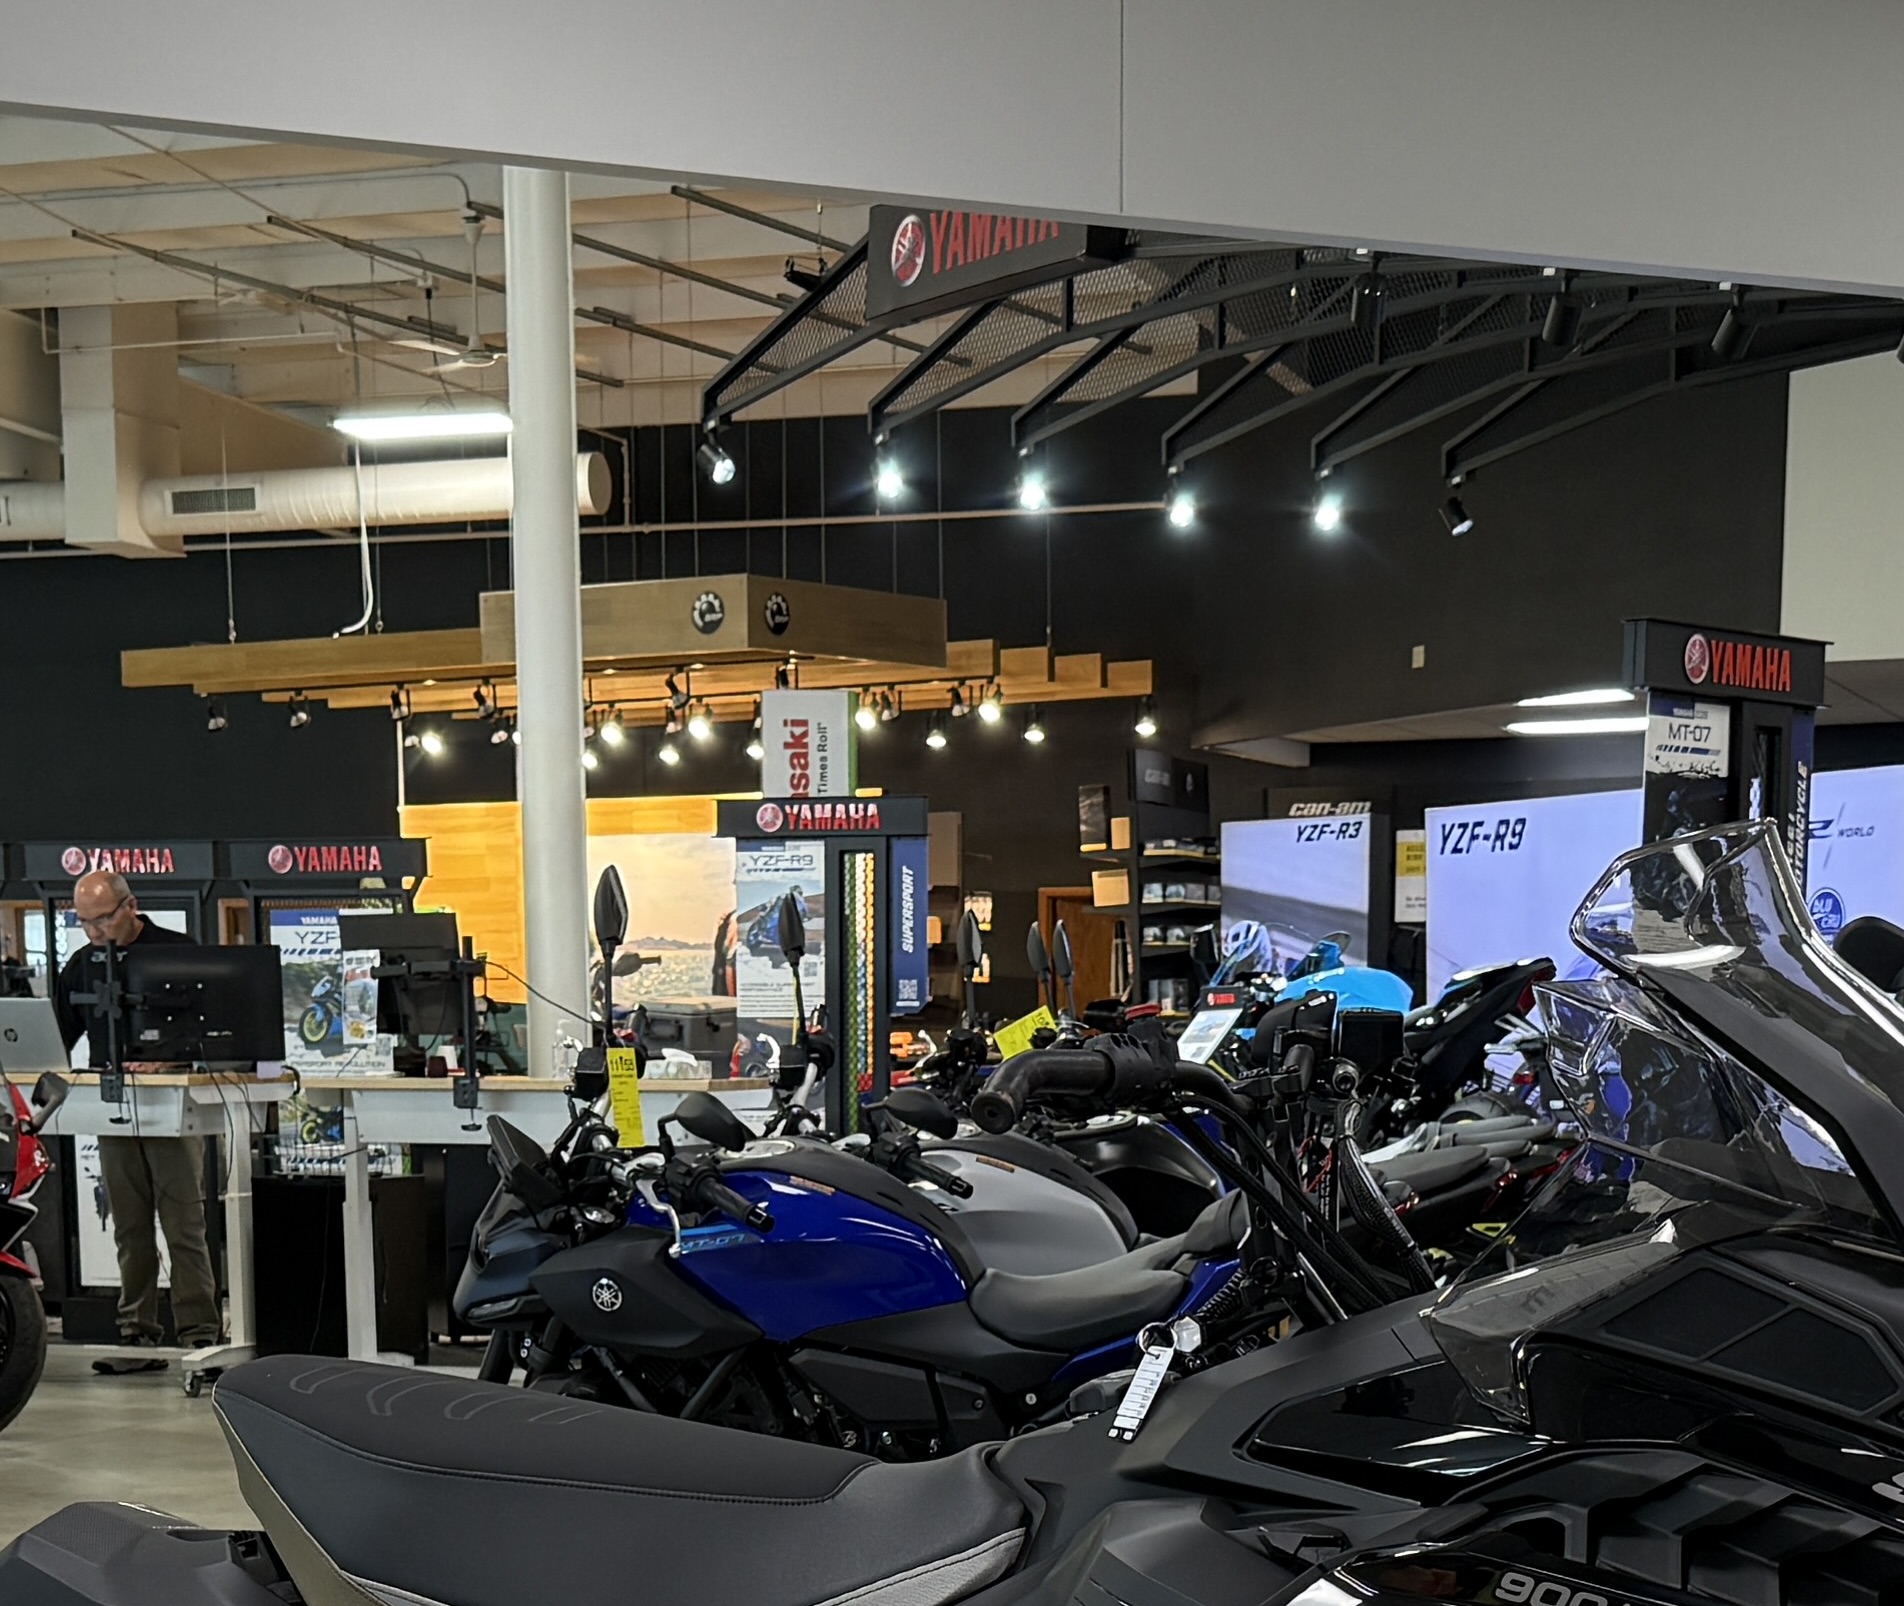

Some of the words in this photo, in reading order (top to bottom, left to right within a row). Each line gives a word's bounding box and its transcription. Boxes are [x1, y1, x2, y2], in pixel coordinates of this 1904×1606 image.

[1710, 638, 1792, 693] YAMAHA
[1668, 722, 1712, 744] MT-07
[817, 758, 829, 795] Times
[785, 802, 881, 831] YAMAHA
[1288, 801, 1372, 817] can-am
[1295, 821, 1364, 844] YZF-R3
[1439, 817, 1528, 856] YZF-R9
[1837, 825, 1875, 838] WORLD
[87, 848, 176, 874] YAMAHA
[293, 845, 383, 872] YAMAHA
[749, 854, 814, 867] YZF-R9
[901, 866, 915, 954] SUPERSPORT
